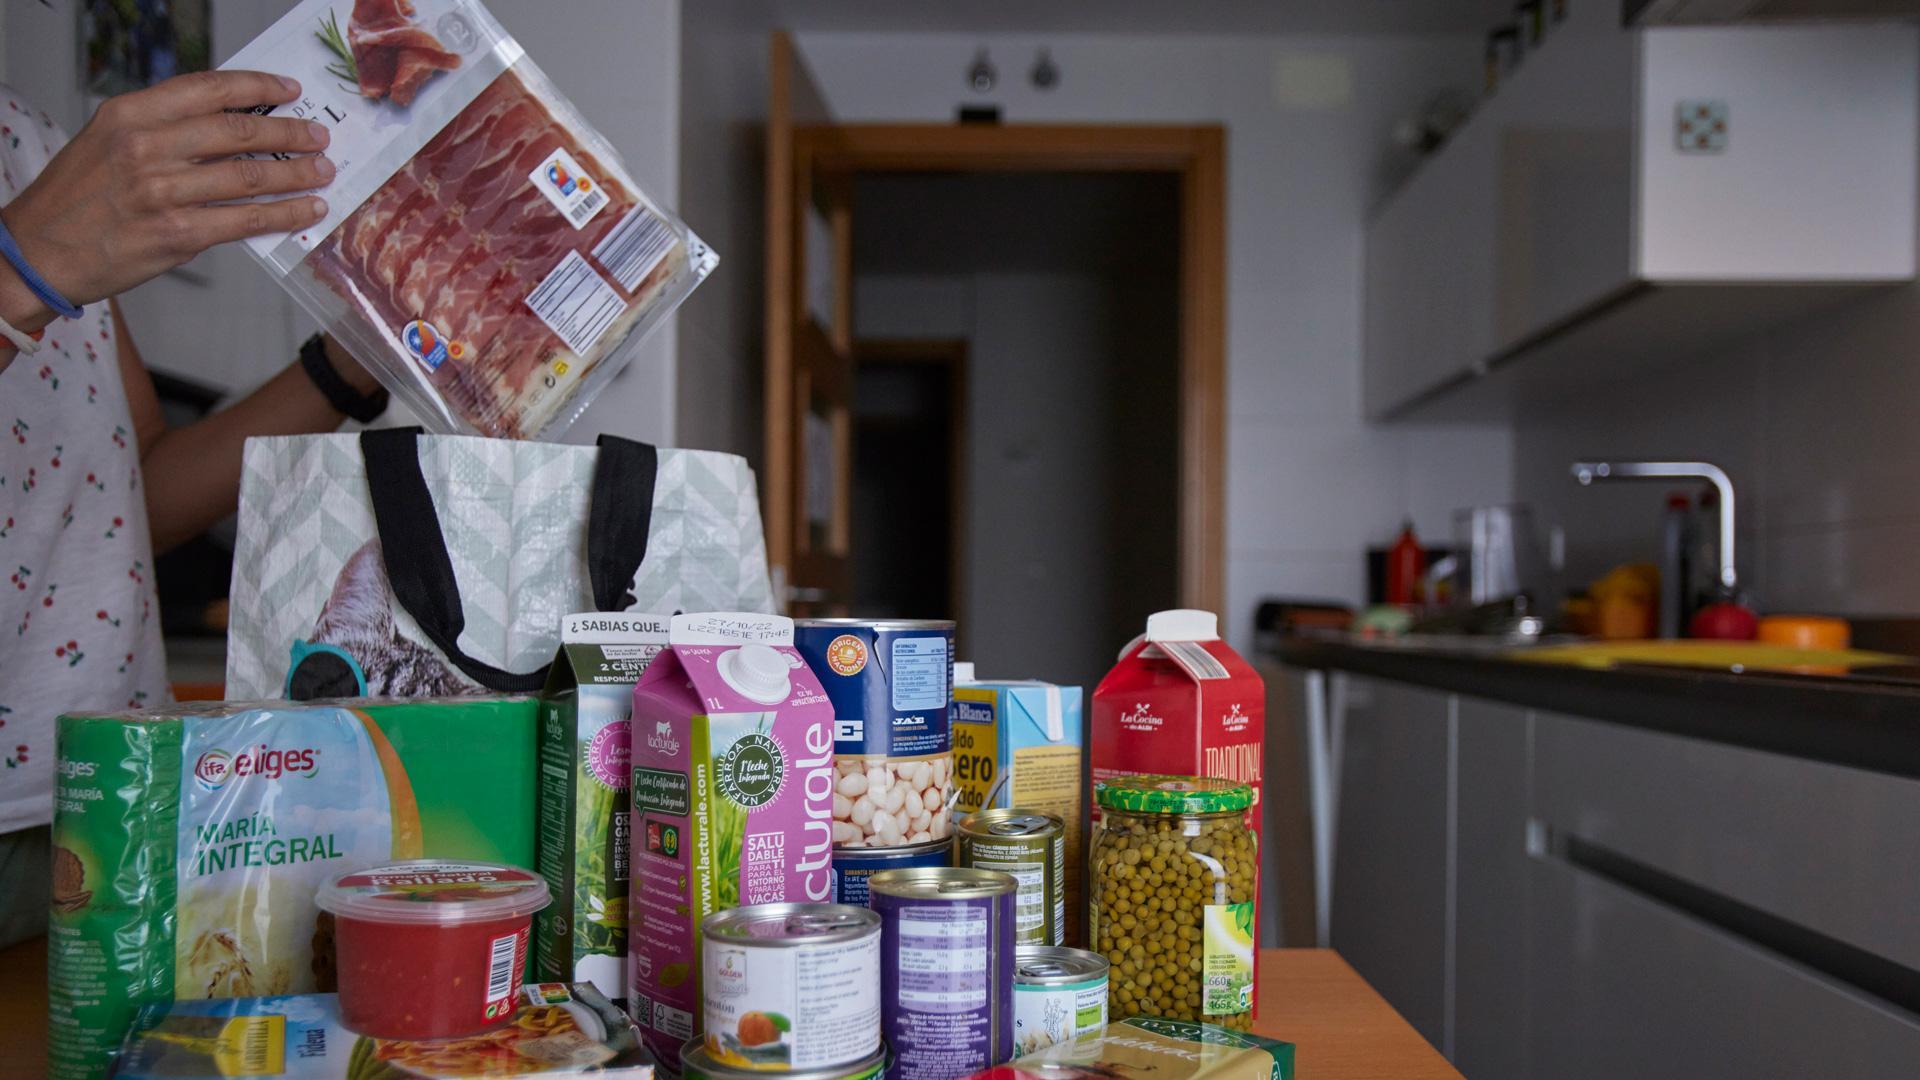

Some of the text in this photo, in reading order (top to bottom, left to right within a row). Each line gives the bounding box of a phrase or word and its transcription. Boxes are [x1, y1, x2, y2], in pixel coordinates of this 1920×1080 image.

[293, 97, 315, 119] DE
[582, 620, 629, 632] SABIAS
[708, 618, 773, 630] 27/10/22
[759, 628, 790, 640] 17:45
[832, 639, 863, 652] ORIGEN
[600, 663, 649, 671] 2 CENT
[831, 655, 864, 672] NACIONAL
[707, 697, 724, 710] 1L
[959, 703, 992, 722] Blanca
[1121, 712, 1163, 725] La Cocina
[1222, 714, 1249, 726] La Cocina
[647, 733, 680, 753] lacturale
[952, 730, 974, 749] ldo
[234, 744, 316, 780] eliges
[754, 735, 783, 793] NAVARRA
[952, 753, 993, 782] sero
[1205, 742, 1262, 784] TRADICIONAL
[724, 743, 759, 806] NAFARROA
[738, 771, 771, 785] Integrada
[796, 722, 832, 904] cturale
[196, 811, 277, 846] MARÍA
[696, 763, 713, 916] www.lacturale.com
[748, 835, 784, 851] SALU
[196, 834, 343, 877] INTEGRAL
[748, 849, 784, 861] DABLE
[748, 859, 784, 873] PARA TI
[371, 875, 497, 885] Rallado
[748, 870, 772, 879] PARA
[748, 876, 784, 887] ENTORNO
[755, 885, 771, 893] PARA
[772, 883, 784, 891] LAS
[748, 891, 784, 904] VACAS
[1209, 976, 1232, 987] 660g
[1209, 1000, 1232, 1009] 465g
